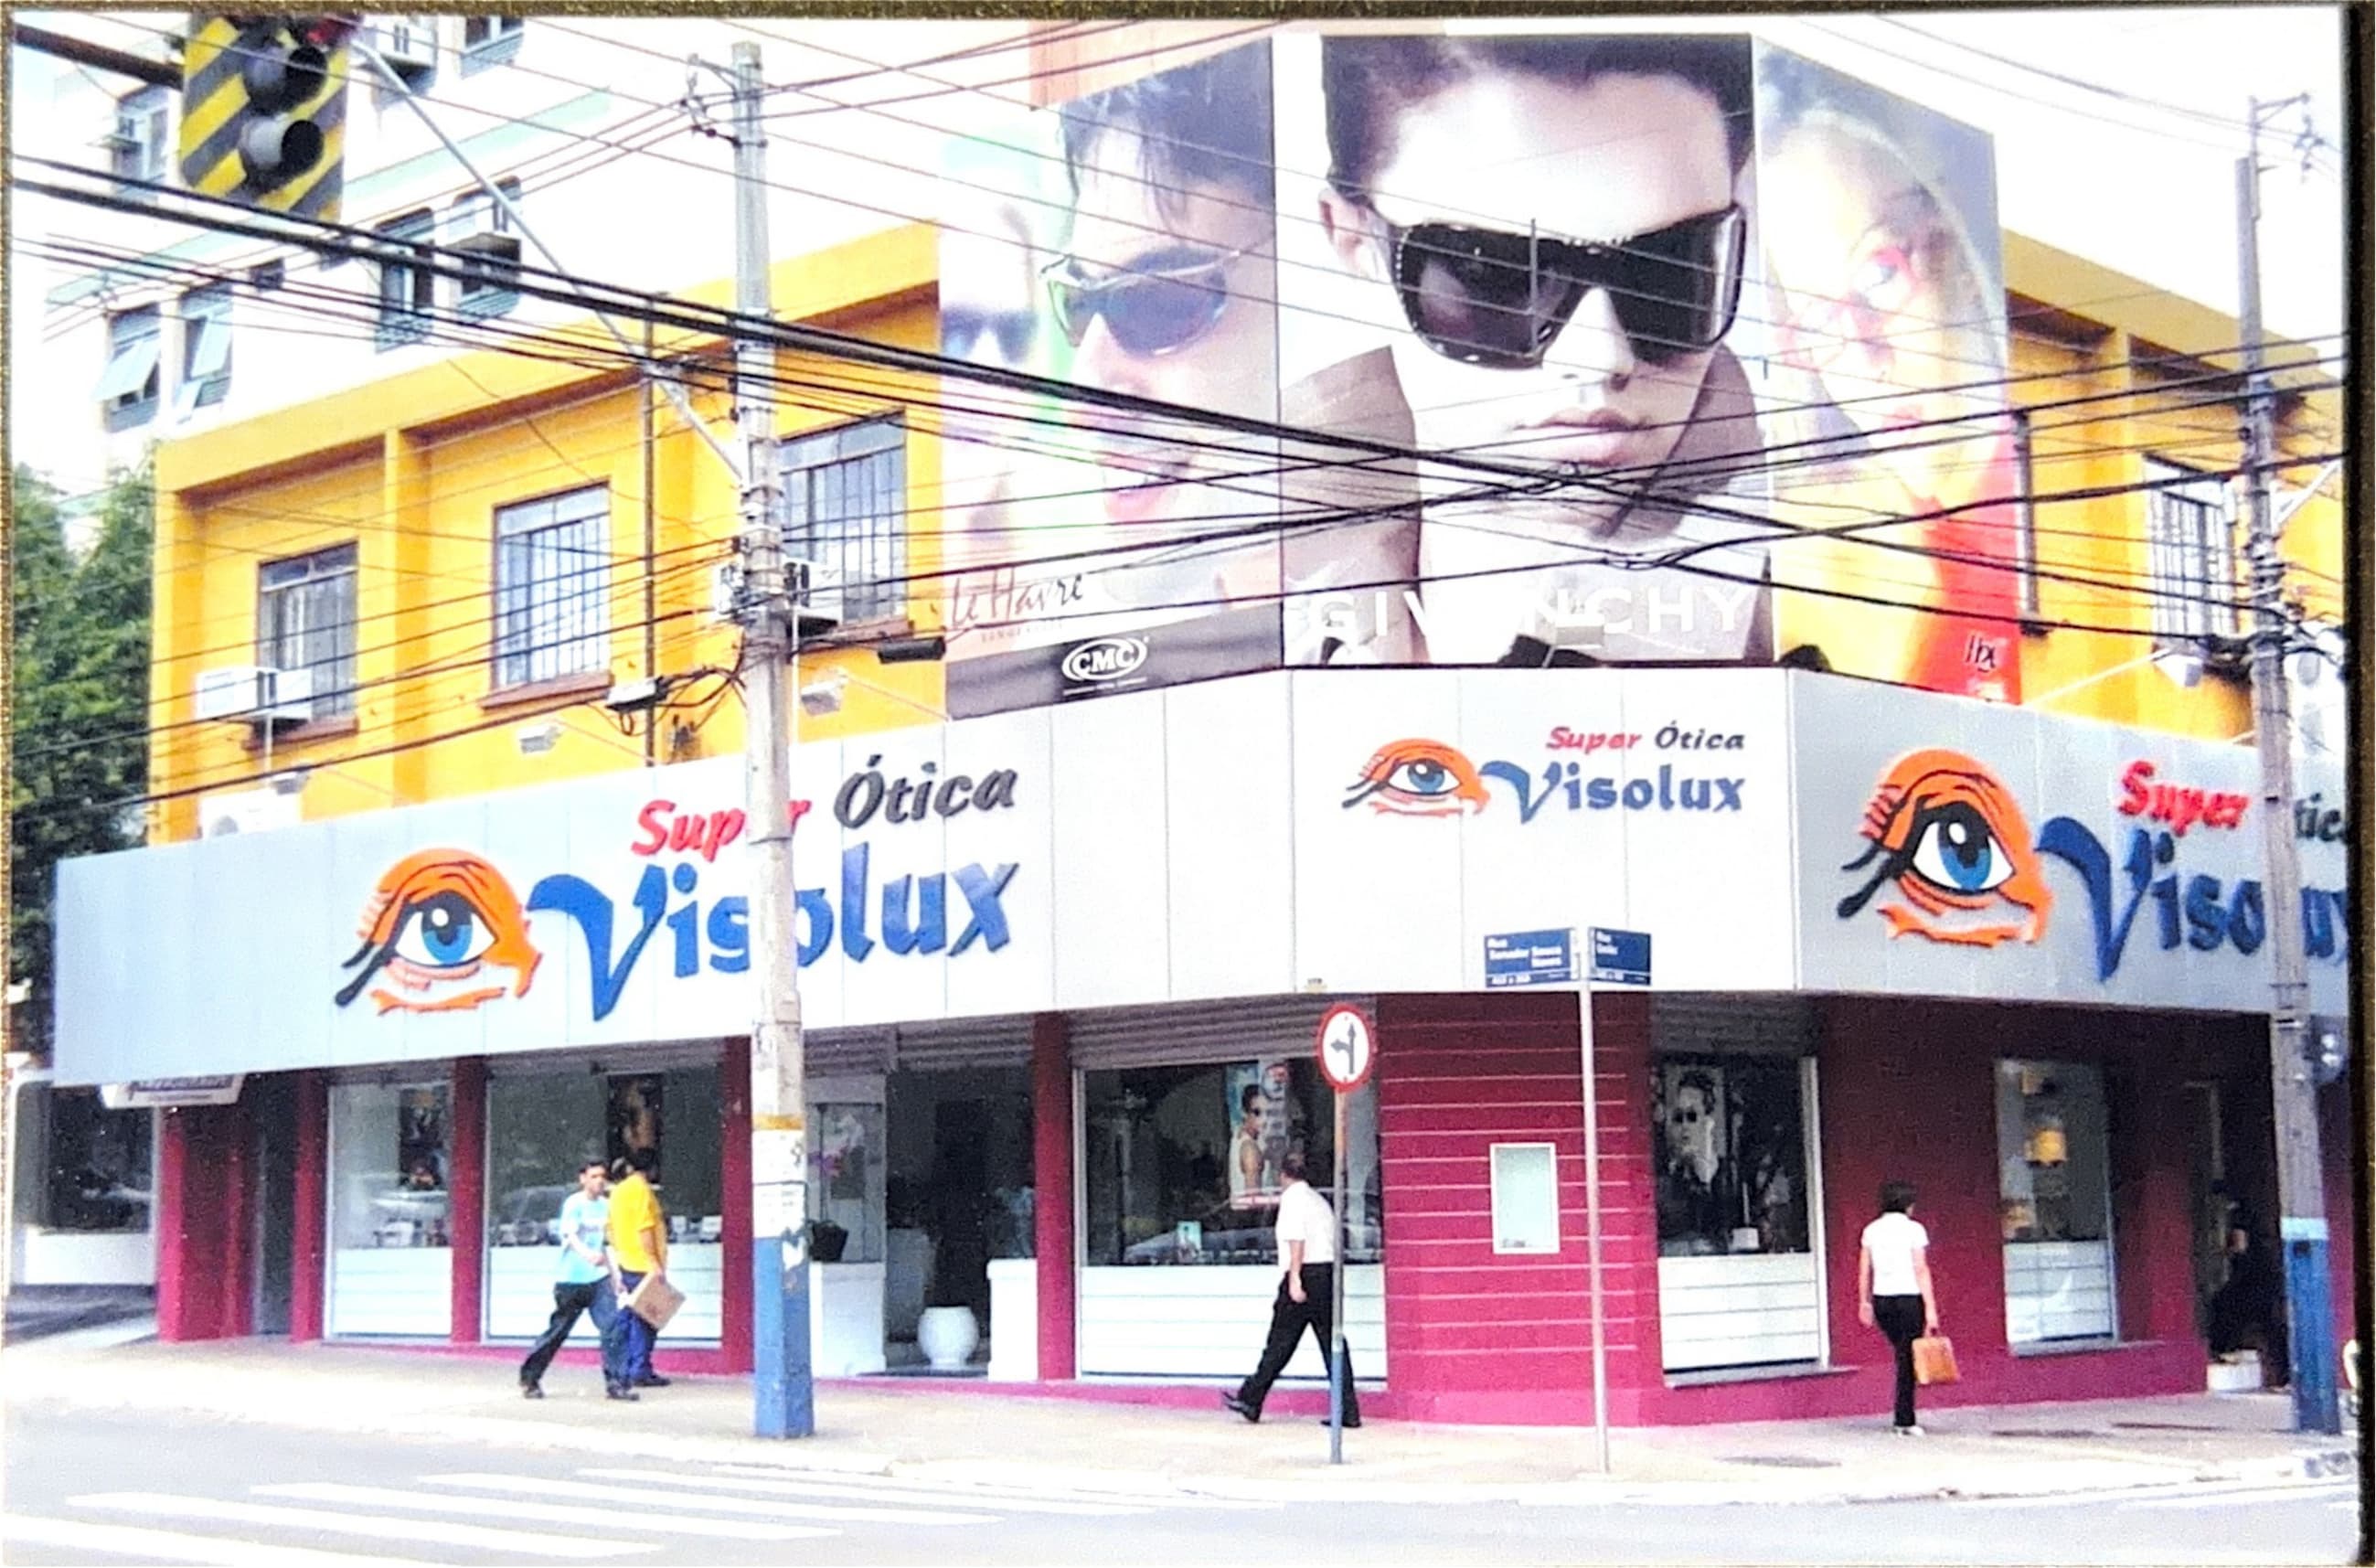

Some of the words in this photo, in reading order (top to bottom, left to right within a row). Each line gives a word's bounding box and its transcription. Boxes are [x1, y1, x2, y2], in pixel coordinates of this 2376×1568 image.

[1308, 583, 1757, 638] GIVNCHY
[1071, 641, 1136, 676] CMC
[1546, 726, 1642, 754] Super
[1655, 720, 1745, 751] Ótica
[631, 799, 812, 863] Supr
[833, 754, 1018, 829] Ótica
[1477, 762, 1745, 825] Visolux
[2117, 760, 2251, 838] Super
